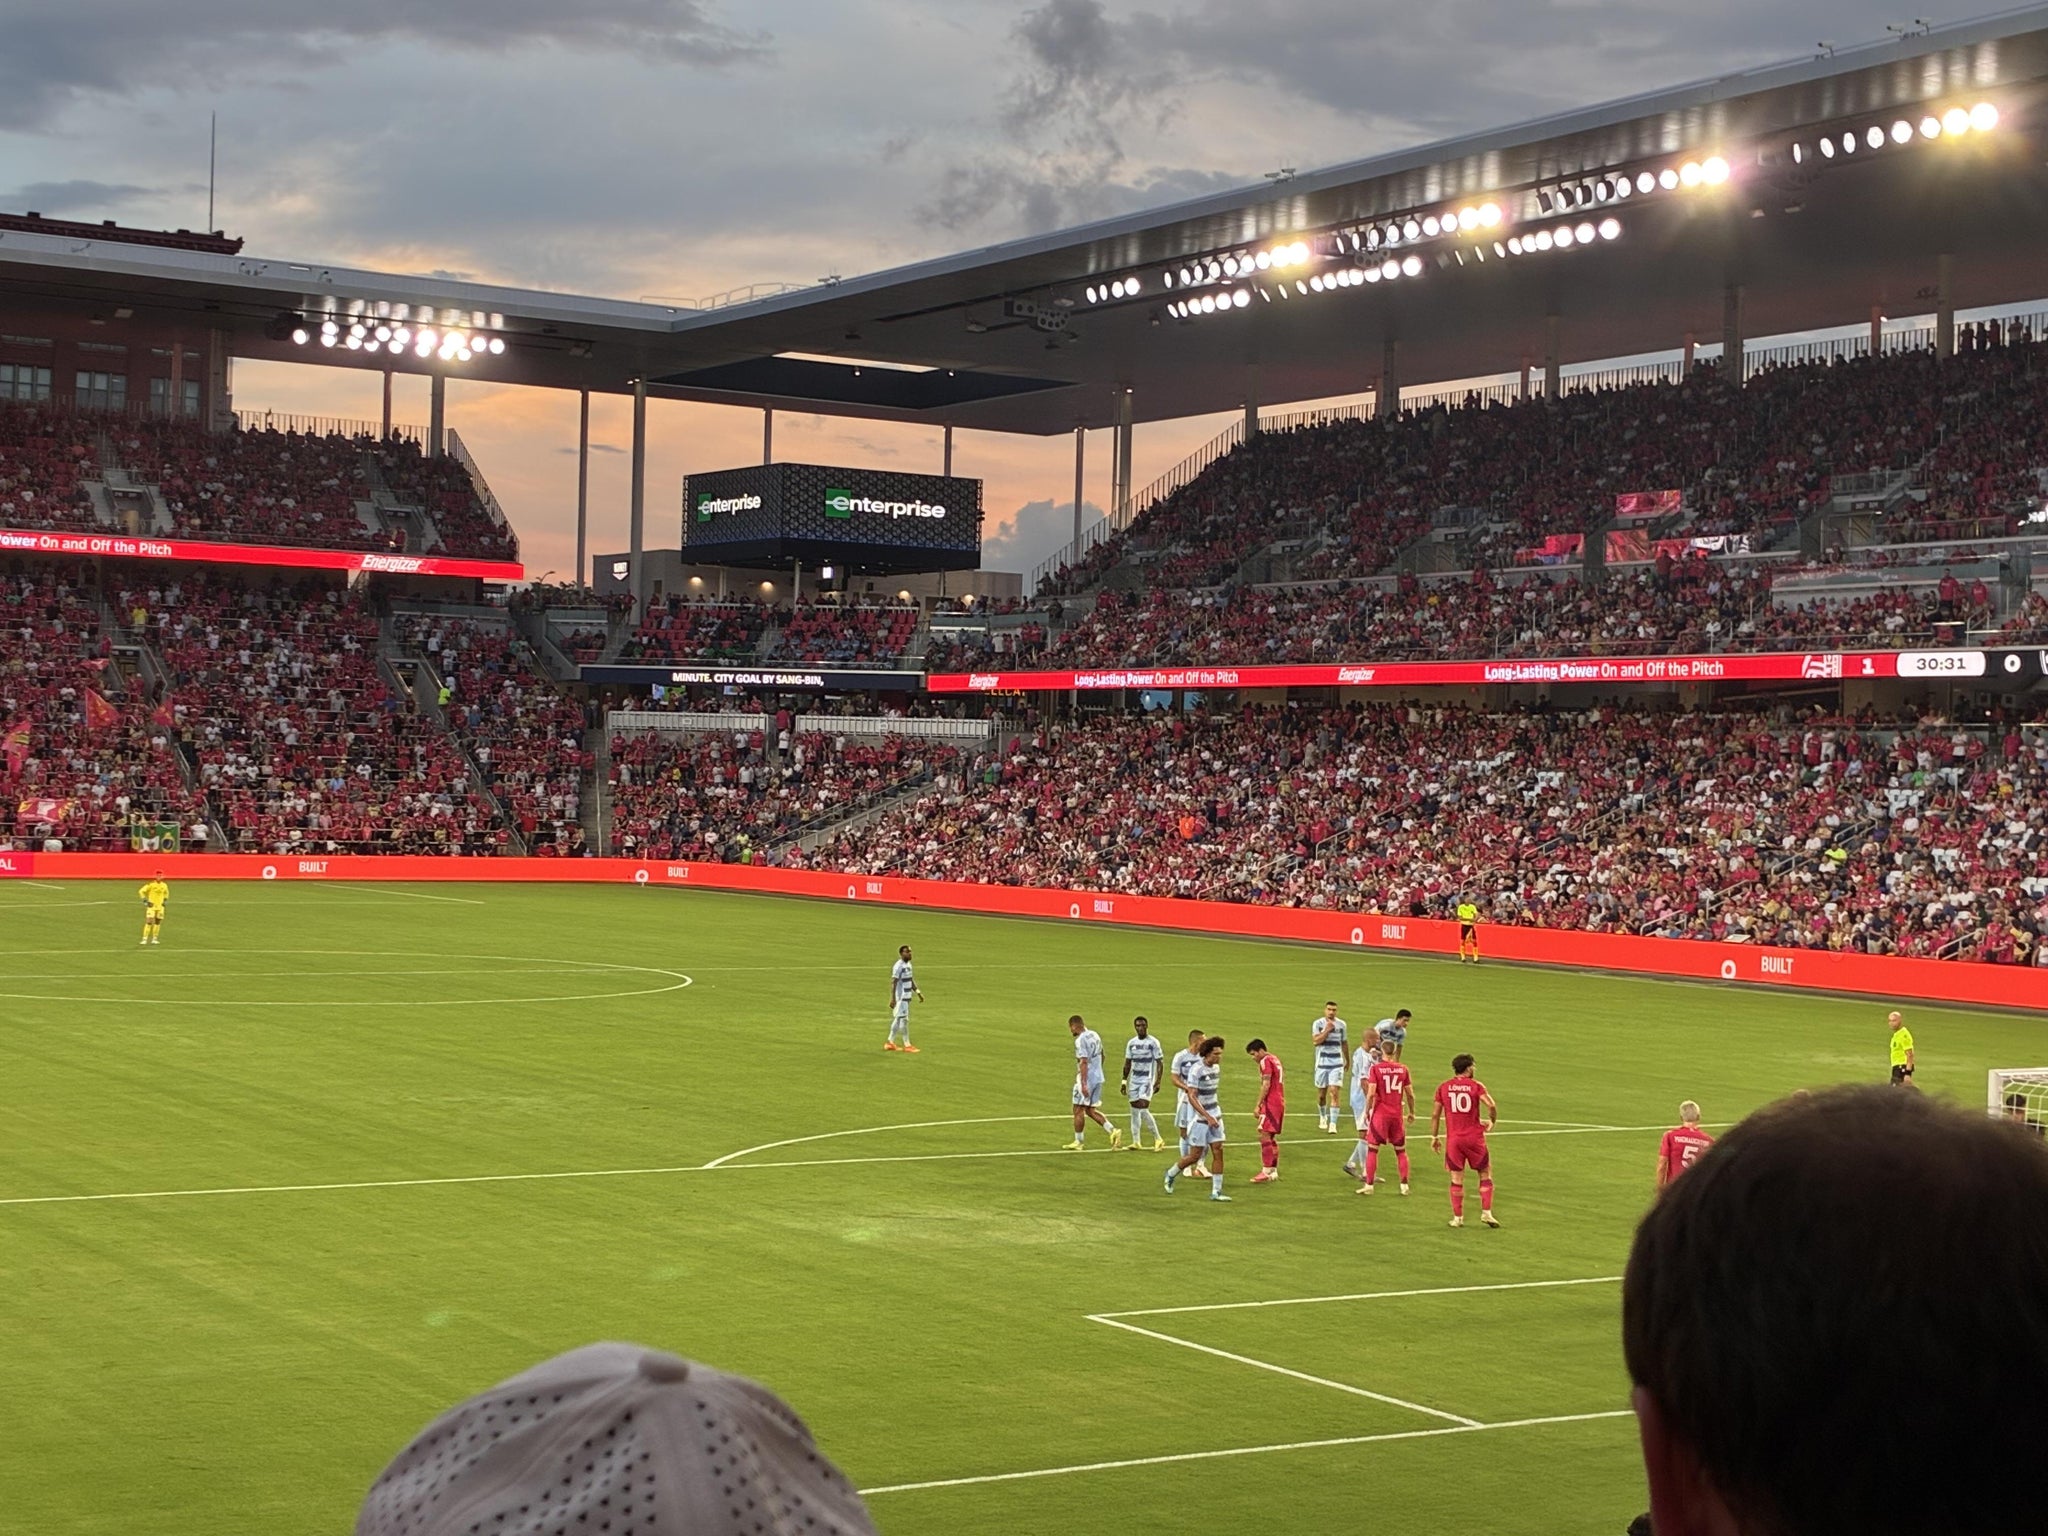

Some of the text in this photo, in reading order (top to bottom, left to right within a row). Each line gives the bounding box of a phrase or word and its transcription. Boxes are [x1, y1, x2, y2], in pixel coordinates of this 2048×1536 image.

[698, 493, 762, 515] enterprise
[827, 495, 946, 519] enterprise
[40, 536, 59, 549] On
[62, 538, 88, 551] and
[91, 538, 112, 552] Off
[114, 541, 136, 554] the
[139, 542, 173, 556] Pitch
[361, 554, 422, 572] Energizer
[1484, 661, 1723, 681] Long-Lasting Power On and Off the Pitch
[1861, 654, 2022, 675] 1 30:31 0
[672, 672, 712, 683] MINUTE.
[714, 673, 734, 684] CITY
[735, 673, 761, 684] GOAL
[763, 674, 775, 684] BY
[1074, 671, 1239, 687] Long-Lasting Power On and Off the Pitch
[1338, 667, 1376, 684] Energizer
[299, 861, 329, 873] BUILT
[667, 866, 690, 878] BUILT
[866, 882, 883, 895] BUILT
[1094, 899, 1115, 914] BUILT
[1382, 924, 1407, 939] BUILT
[1760, 956, 1794, 975] BUILT
[1382, 1075, 1403, 1094] 14
[1448, 1092, 1472, 1113] 10
